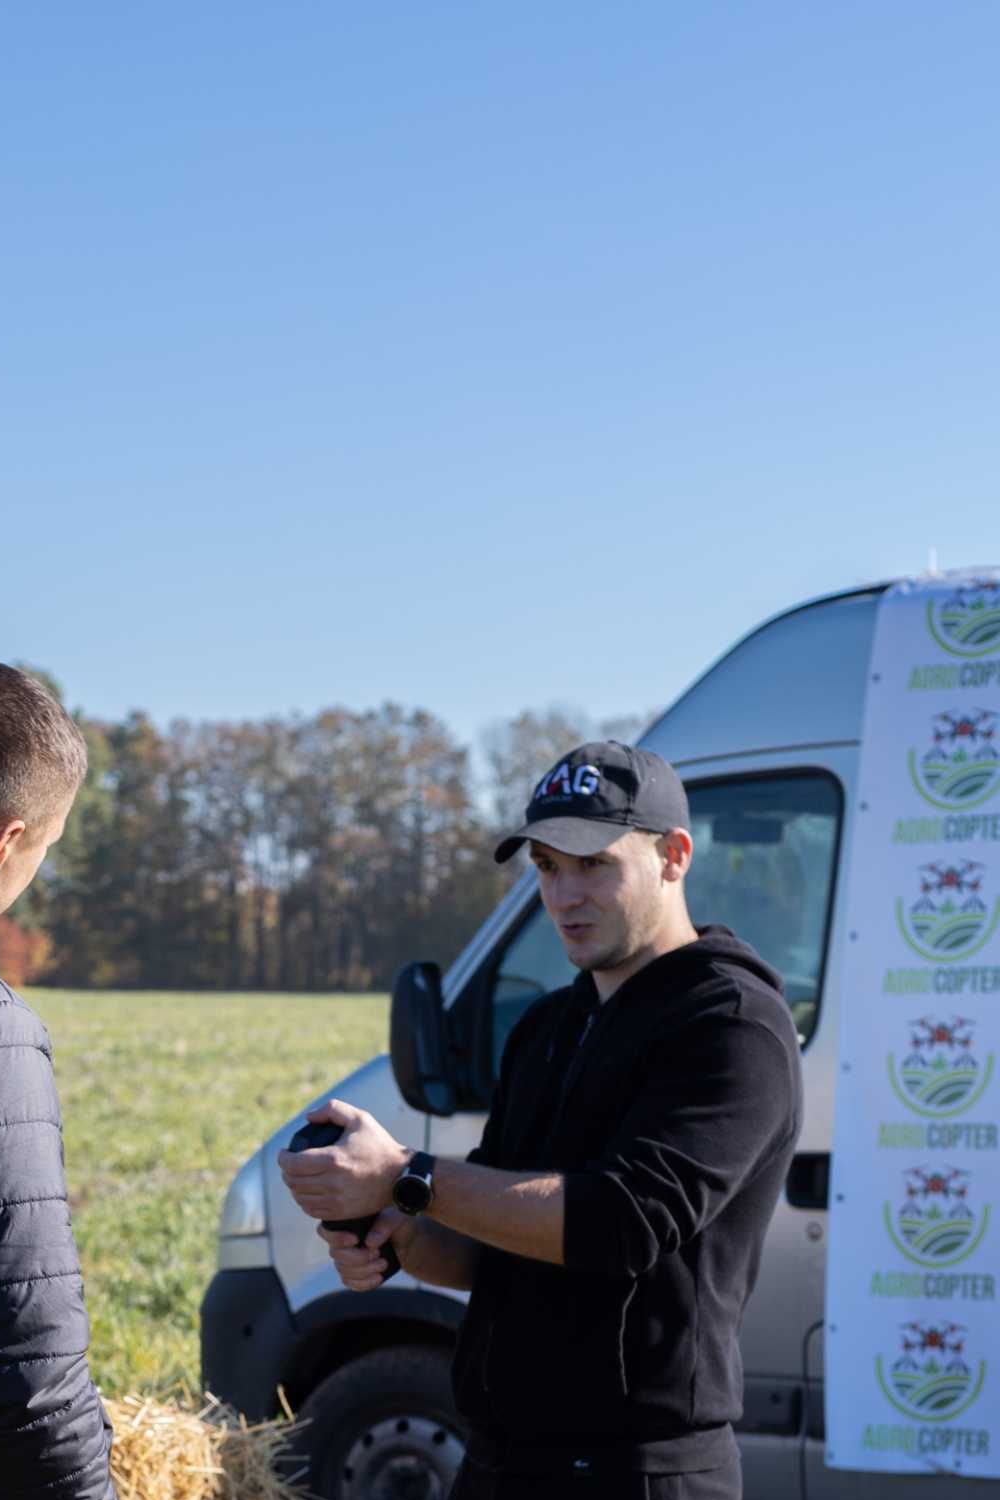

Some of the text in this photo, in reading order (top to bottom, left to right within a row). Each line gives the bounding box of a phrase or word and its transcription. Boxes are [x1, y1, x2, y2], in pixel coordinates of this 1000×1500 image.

[875, 1119, 998, 1151] AGROCOPTER
[869, 1270, 995, 1301] AGROCOPTER
[861, 1422, 989, 1457] AGROCOPTER
